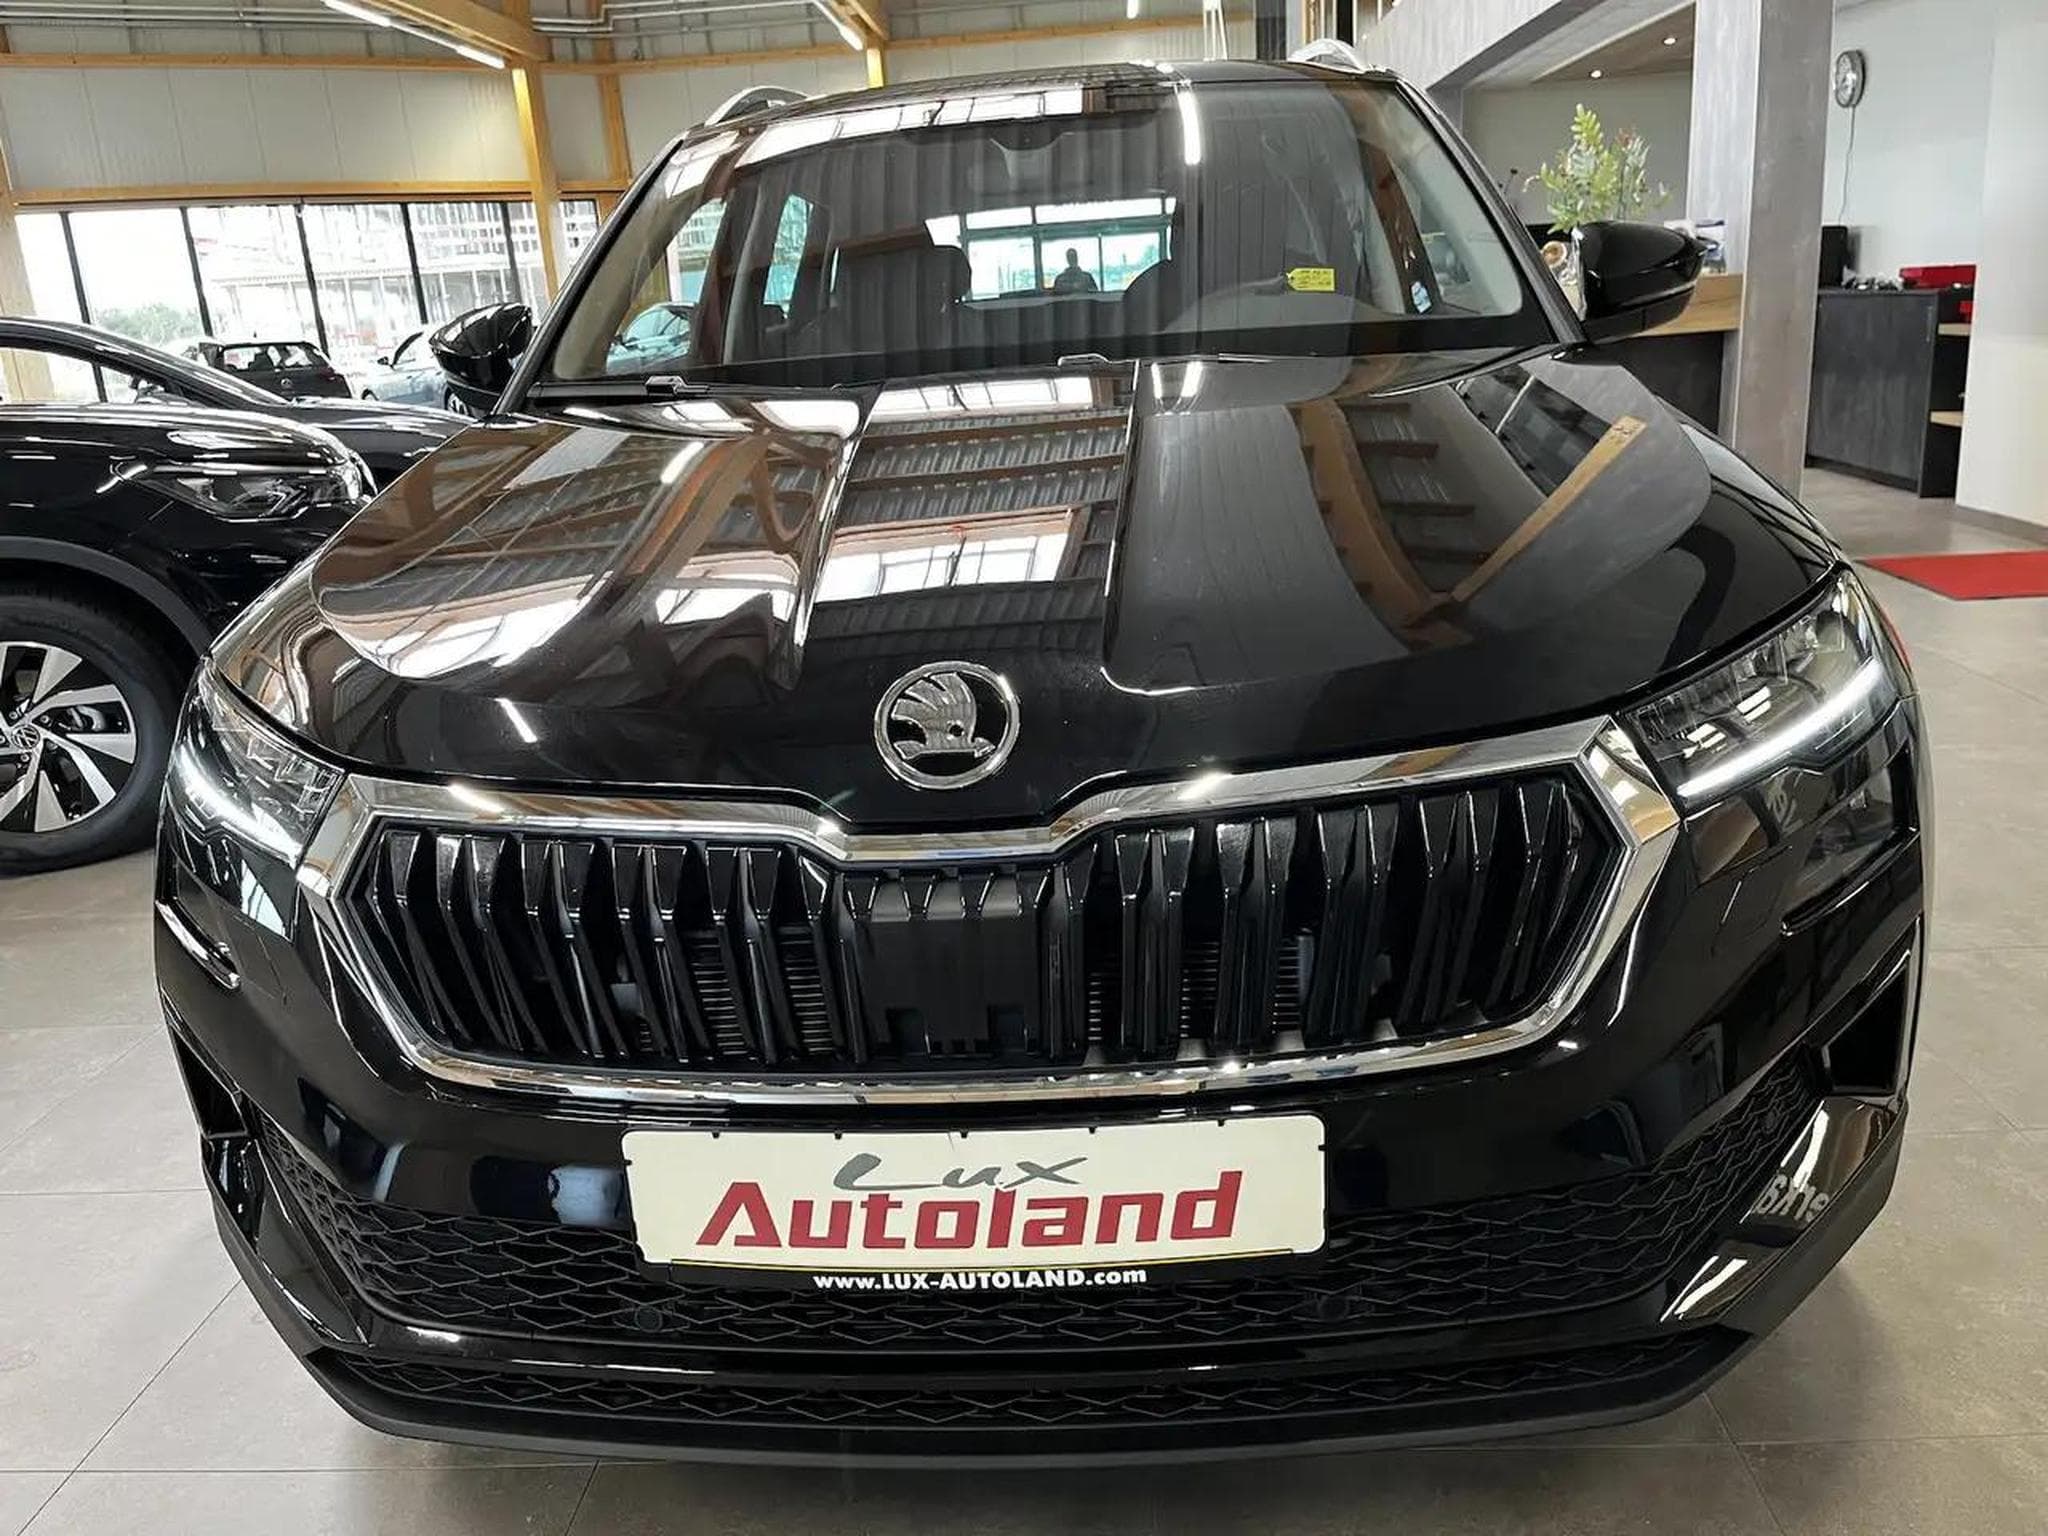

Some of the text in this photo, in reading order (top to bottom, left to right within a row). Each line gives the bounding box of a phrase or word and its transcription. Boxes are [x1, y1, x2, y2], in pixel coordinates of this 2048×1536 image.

[833, 1152, 1089, 1191] Lux
[695, 1171, 1243, 1250] Autoland
[813, 1268, 1147, 1291] www.LUX-AUTOLAND.com
